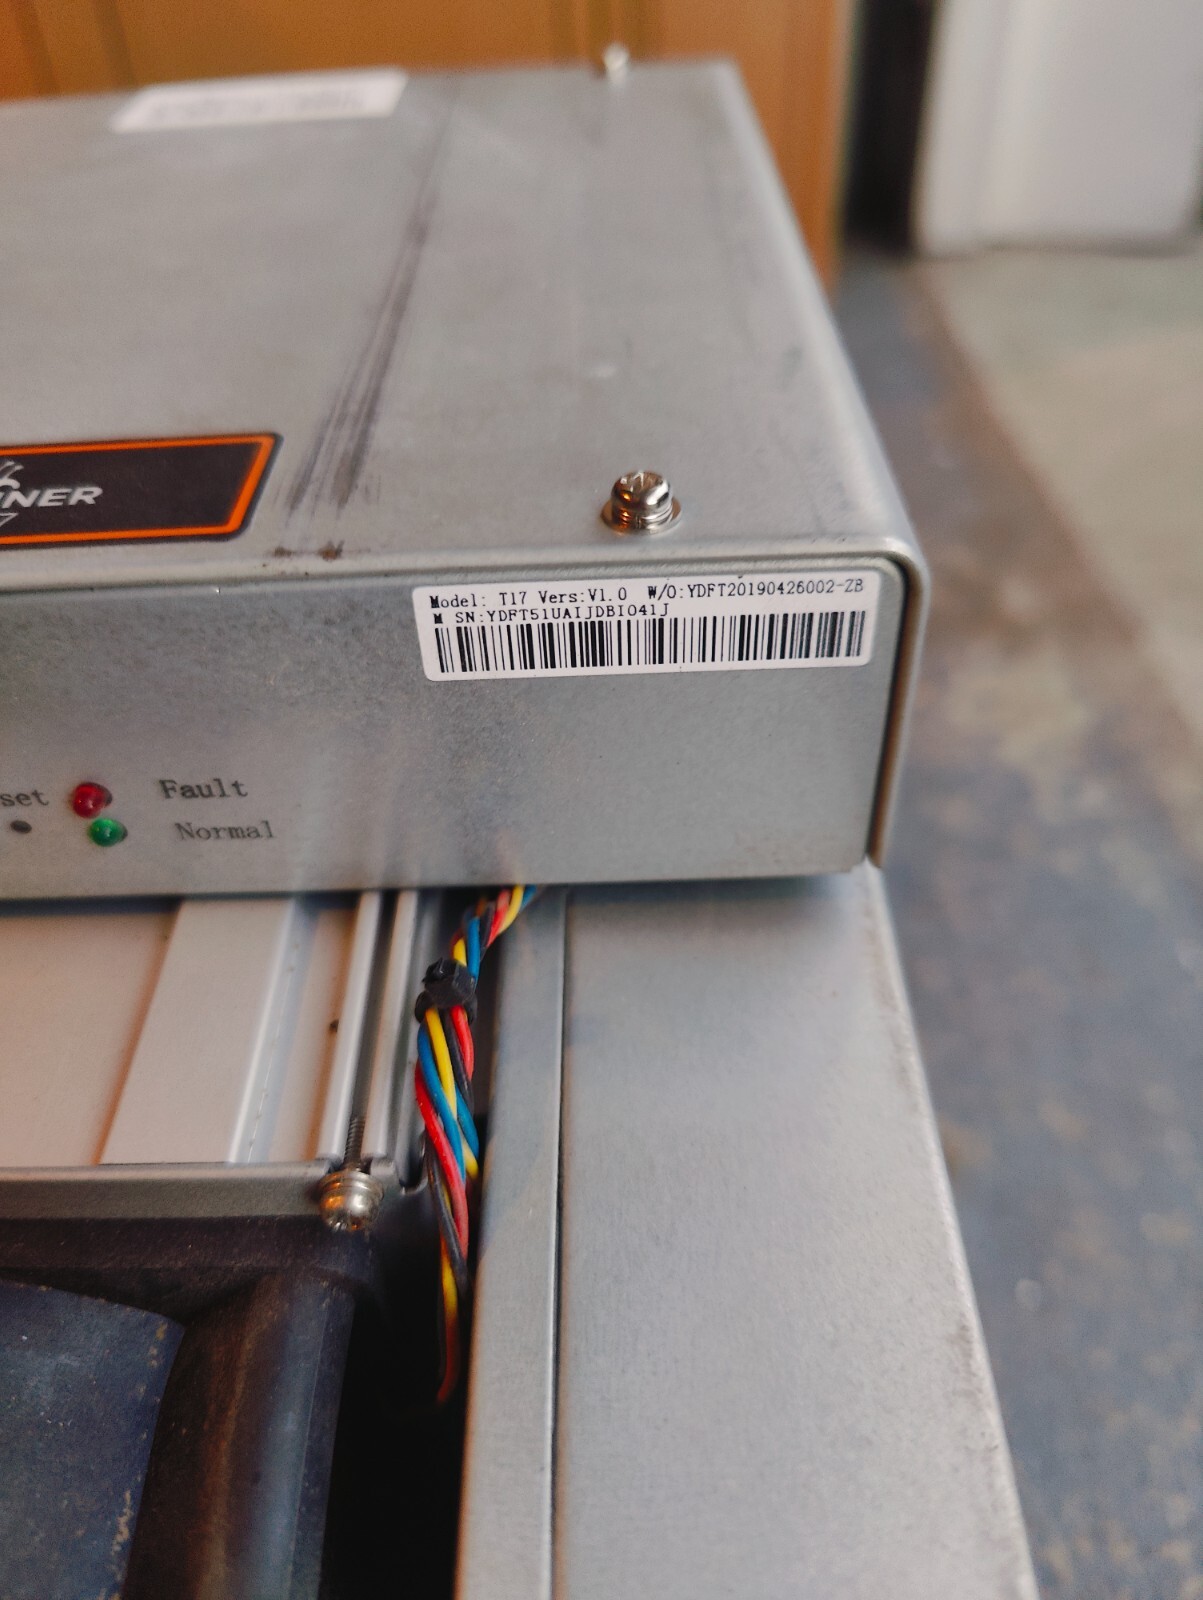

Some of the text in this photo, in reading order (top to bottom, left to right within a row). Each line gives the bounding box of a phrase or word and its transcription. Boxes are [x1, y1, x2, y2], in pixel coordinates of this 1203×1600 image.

[430, 594, 486, 608] Model:
[499, 592, 527, 605] T17
[538, 588, 627, 603] Vers:V1.0
[0, 789, 49, 806] set
[159, 778, 248, 798] Fault
[175, 820, 276, 840] Normal
